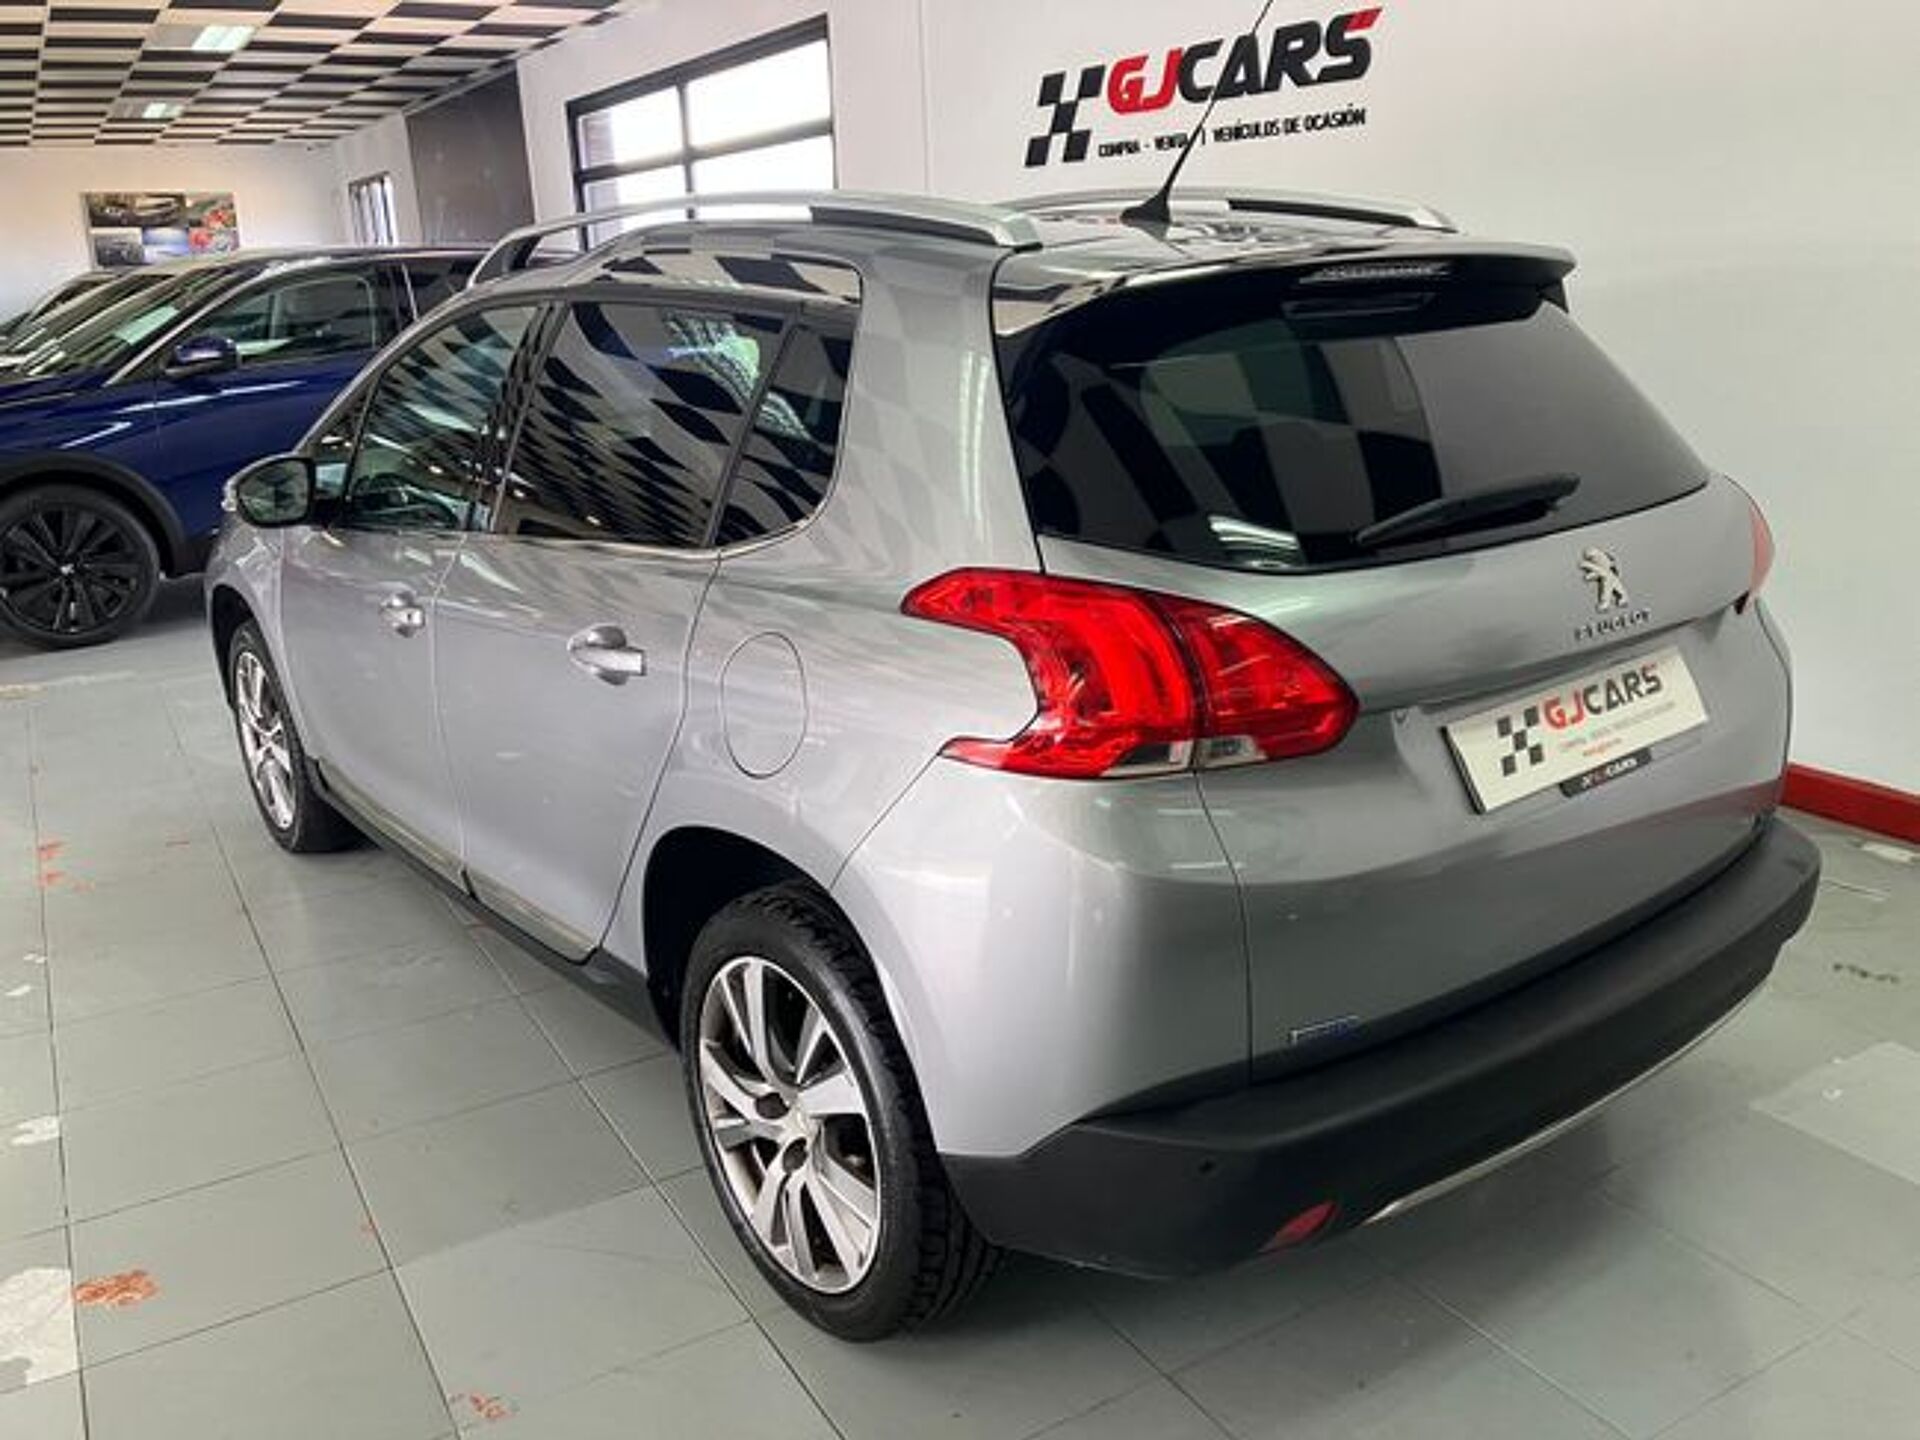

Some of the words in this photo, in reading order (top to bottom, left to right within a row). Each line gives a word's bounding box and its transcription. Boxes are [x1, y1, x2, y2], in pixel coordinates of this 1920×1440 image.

[1106, 7, 1382, 115] GJCARS
[1285, 117, 1301, 135] DE
[1304, 102, 1367, 131] OCASIÓN
[1543, 660, 1664, 730] GJCARS
